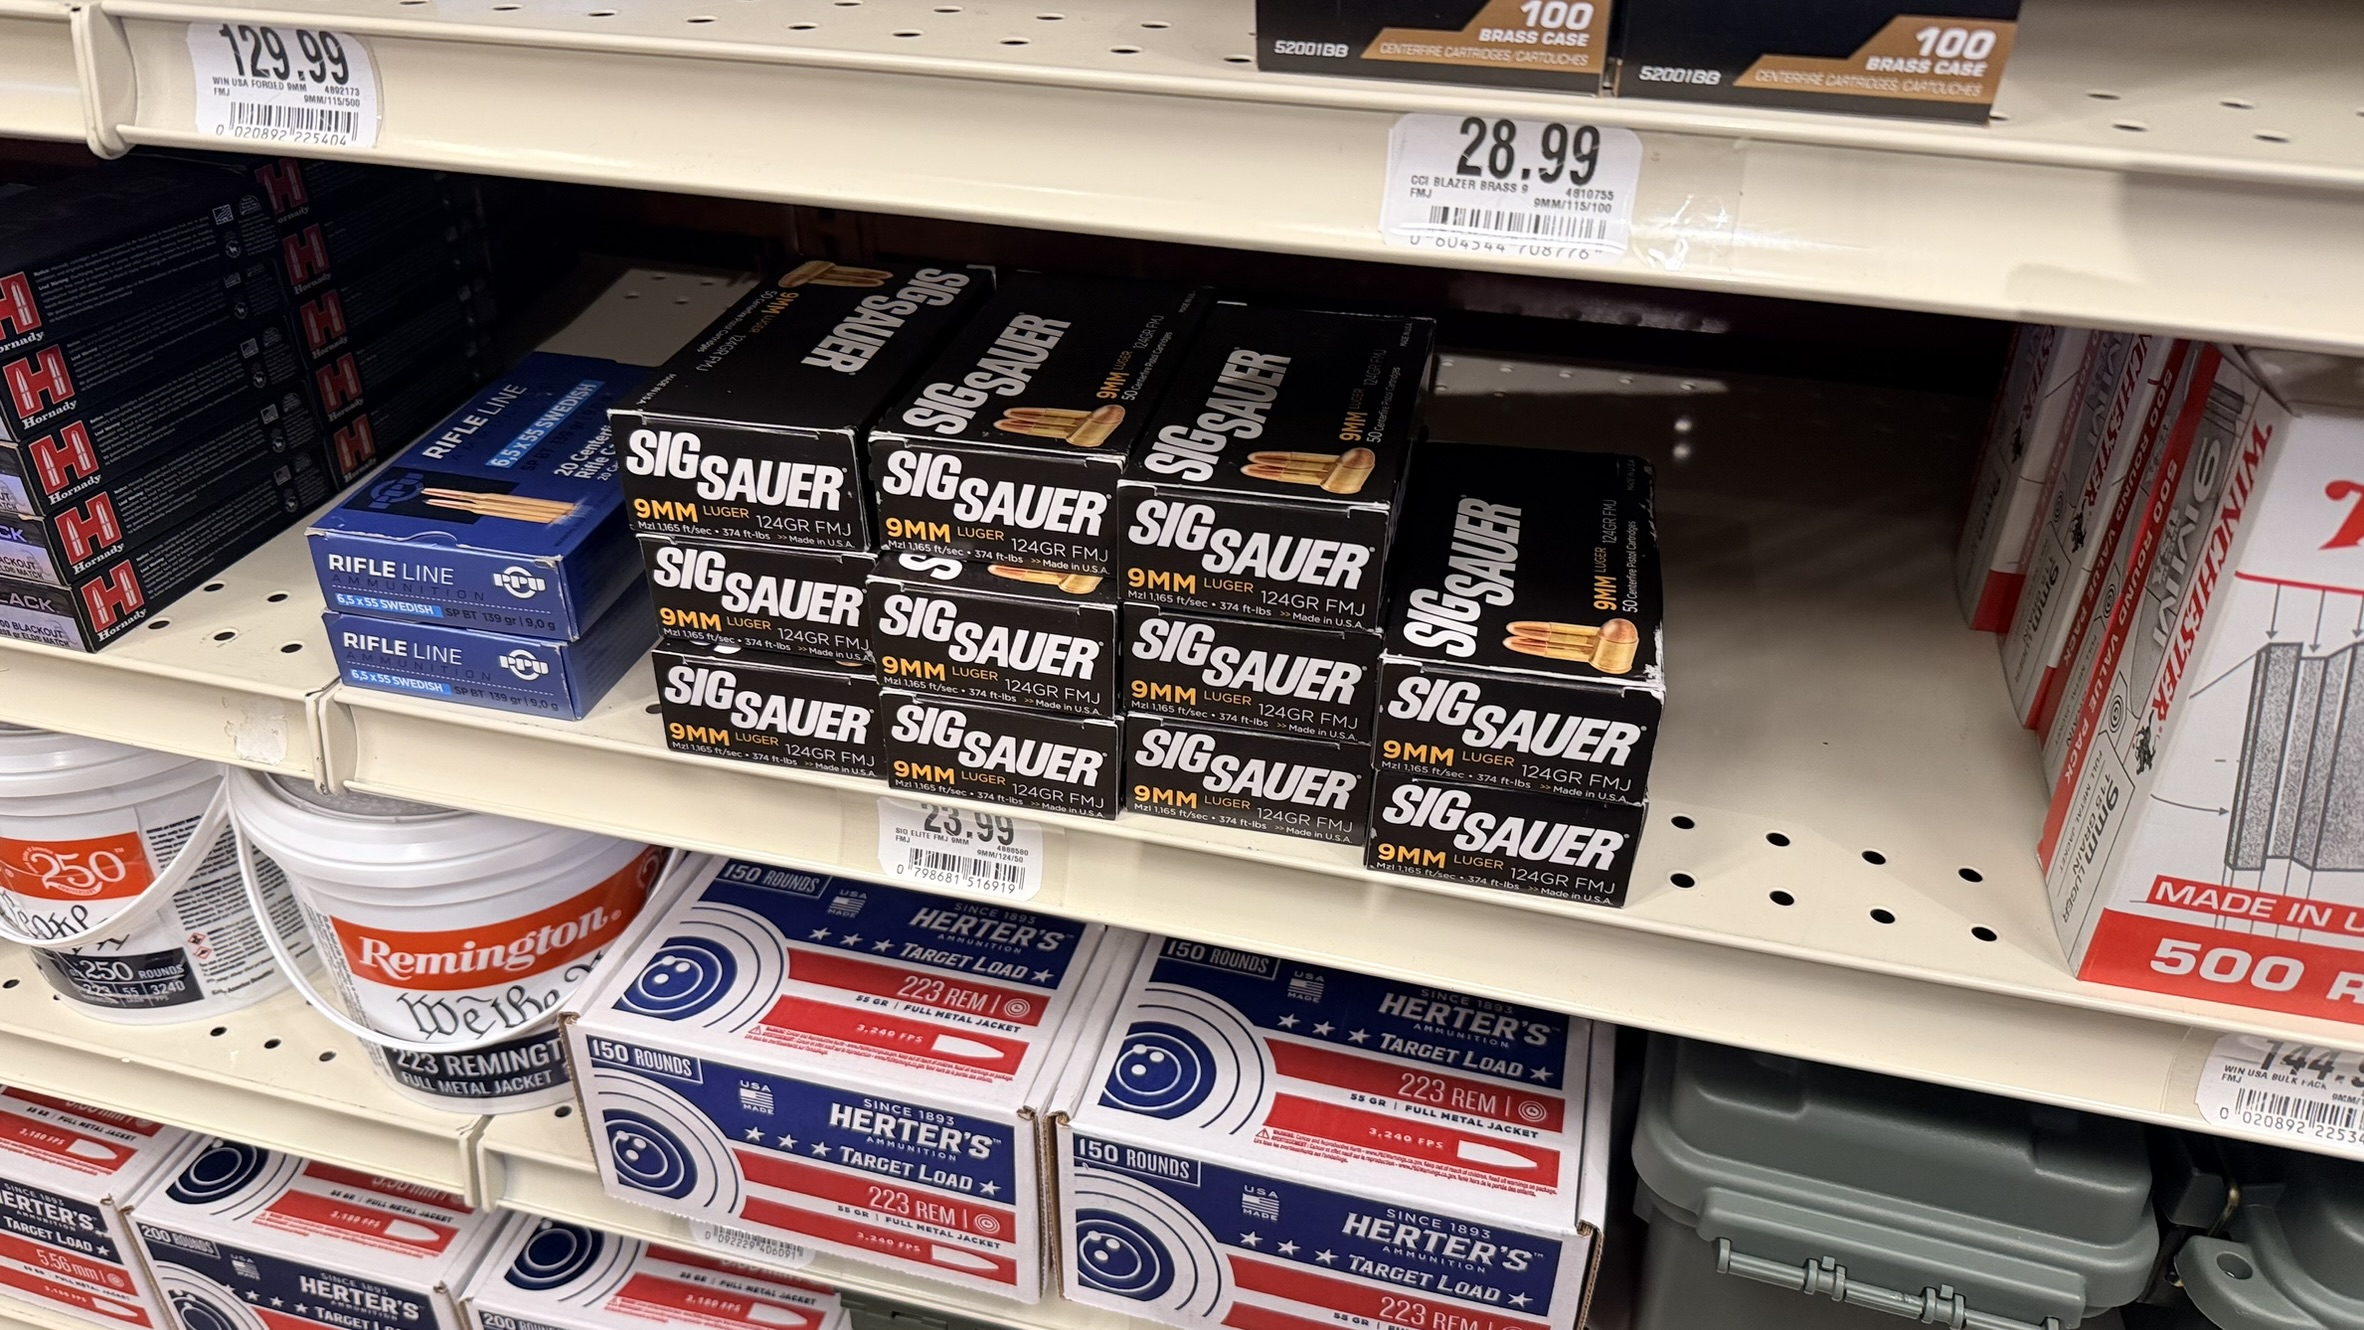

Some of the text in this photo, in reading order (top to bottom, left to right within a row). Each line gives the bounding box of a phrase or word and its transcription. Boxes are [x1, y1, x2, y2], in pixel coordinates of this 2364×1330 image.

[1520, 1, 1594, 31] 100
[219, 23, 349, 85] 129.99
[1274, 40, 1349, 58] 52001BB
[1479, 28, 1589, 47] BRASS CASE
[1915, 26, 1996, 60] 100
[1639, 65, 1722, 85] 52001BB
[1865, 56, 1988, 78] BRASS CASE
[212, 76, 307, 92] WIN USA FORGED 9MM
[213, 87, 230, 97] FMJ
[324, 85, 360, 97] 4892173
[304, 95, 360, 107] 9MM/115/500
[234, 126, 287, 141] 020892
[1456, 116, 1600, 186] 28.99
[1410, 188, 1432, 199] FMJ
[1411, 175, 1517, 193] CCI BLAZER BRASS
[1565, 188, 1614, 201] 4810755
[1533, 198, 1612, 213] 9MM/115/100
[896, 267, 971, 316] SIG
[801, 294, 907, 376] SAUER
[963, 313, 1071, 397] SAUER
[535, 383, 597, 429] SWEDISH
[903, 382, 989, 436] SIG
[1196, 349, 1292, 440] SAUER
[21, 400, 78, 431] Hornady
[422, 383, 528, 460] RIFLE LINE
[626, 429, 844, 511] SIG SAUER
[1144, 424, 1228, 483] SIG
[48, 473, 102, 505] Hornady
[882, 450, 1108, 537] SIG SAUER
[634, 498, 749, 523] 9MM LUGER
[755, 515, 851, 537] 124GR FMJ
[1602, 499, 1617, 544] 124GR FMJ
[683, 524, 712, 536] ft/sec
[722, 528, 771, 541] 374 ft-lbs
[789, 534, 814, 545] Made
[817, 537, 825, 545] in
[1128, 499, 1370, 590] SIG SAUER
[1444, 497, 1522, 607] SAUER
[329, 554, 454, 586] RIFLE LINE
[493, 573, 546, 592] PPU
[1593, 547, 1617, 611] 9MM LUGER
[2153, 423, 2272, 721] WINCHESTER
[332, 574, 484, 601] AMMUNITION
[337, 593, 433, 616] 6,5 55 SWEDISH
[447, 608, 517, 627] SP BT 139 gr
[12, 621, 63, 638] BLACKOUT
[97, 608, 147, 641] Hornady
[1403, 588, 1482, 658] SIG
[2065, 459, 2178, 784] 500 ROUND VALUE PACK
[343, 632, 462, 665] RIFLE LINE
[499, 655, 549, 675] PPU
[392, 676, 443, 693] SWEDISH
[664, 665, 871, 745] SIG SAUER
[1387, 676, 1641, 767] SIG SAUER
[891, 704, 1104, 787] SIG SAUER
[1382, 739, 1515, 767] 9MM LUGER
[1521, 764, 1632, 792] 124GR FMJ
[895, 827, 970, 846] SIG ELITE FMJ 9MM
[895, 835, 910, 843] FMJ
[921, 803, 1014, 846] 23.99
[1382, 784, 1624, 871] SIG SAUER
[31, 850, 127, 889] 250
[976, 849, 1024, 864] 9MM/124/50
[2062, 785, 2120, 924] 9mm LUGER
[724, 864, 820, 892] 150 ROUNDS
[896, 864, 1016, 894] 0 798681 516919
[2154, 881, 2333, 926] MADE IN
[359, 906, 608, 981] Remington
[909, 908, 1066, 952] HERTER'S
[80, 960, 185, 980] 250 ROUNDS
[1166, 941, 1269, 974] 150 ROUNDS
[2150, 937, 2305, 992] 500
[150, 979, 185, 997] 3240
[1378, 992, 1551, 1046] HERTER'S
[592, 1040, 693, 1077] 150 ROUNDS
[2224, 1064, 2298, 1085] WIN USA BULK
[402, 1069, 552, 1096] FULL METAL JACKET
[1399, 1072, 1494, 1116] 223 REM
[2221, 1073, 2241, 1083] FMJ
[829, 1103, 995, 1160] HERTER'S
[1404, 1104, 1538, 1139] FULL METAL JACKET
[2219, 1107, 2305, 1134] 0 020892
[839, 1145, 974, 1191] TARGET LOAD
[1078, 1138, 1190, 1180] 150 ROUNDS
[868, 1186, 956, 1227] 223 REM
[3, 1215, 93, 1252] TARGET LOAD
[141, 1225, 214, 1254] 200 ROUNDS
[1342, 1211, 1533, 1274] HERTER'S
[1348, 1253, 1501, 1302] TARGET LOAD
[300, 1275, 420, 1320] HERTER'S
